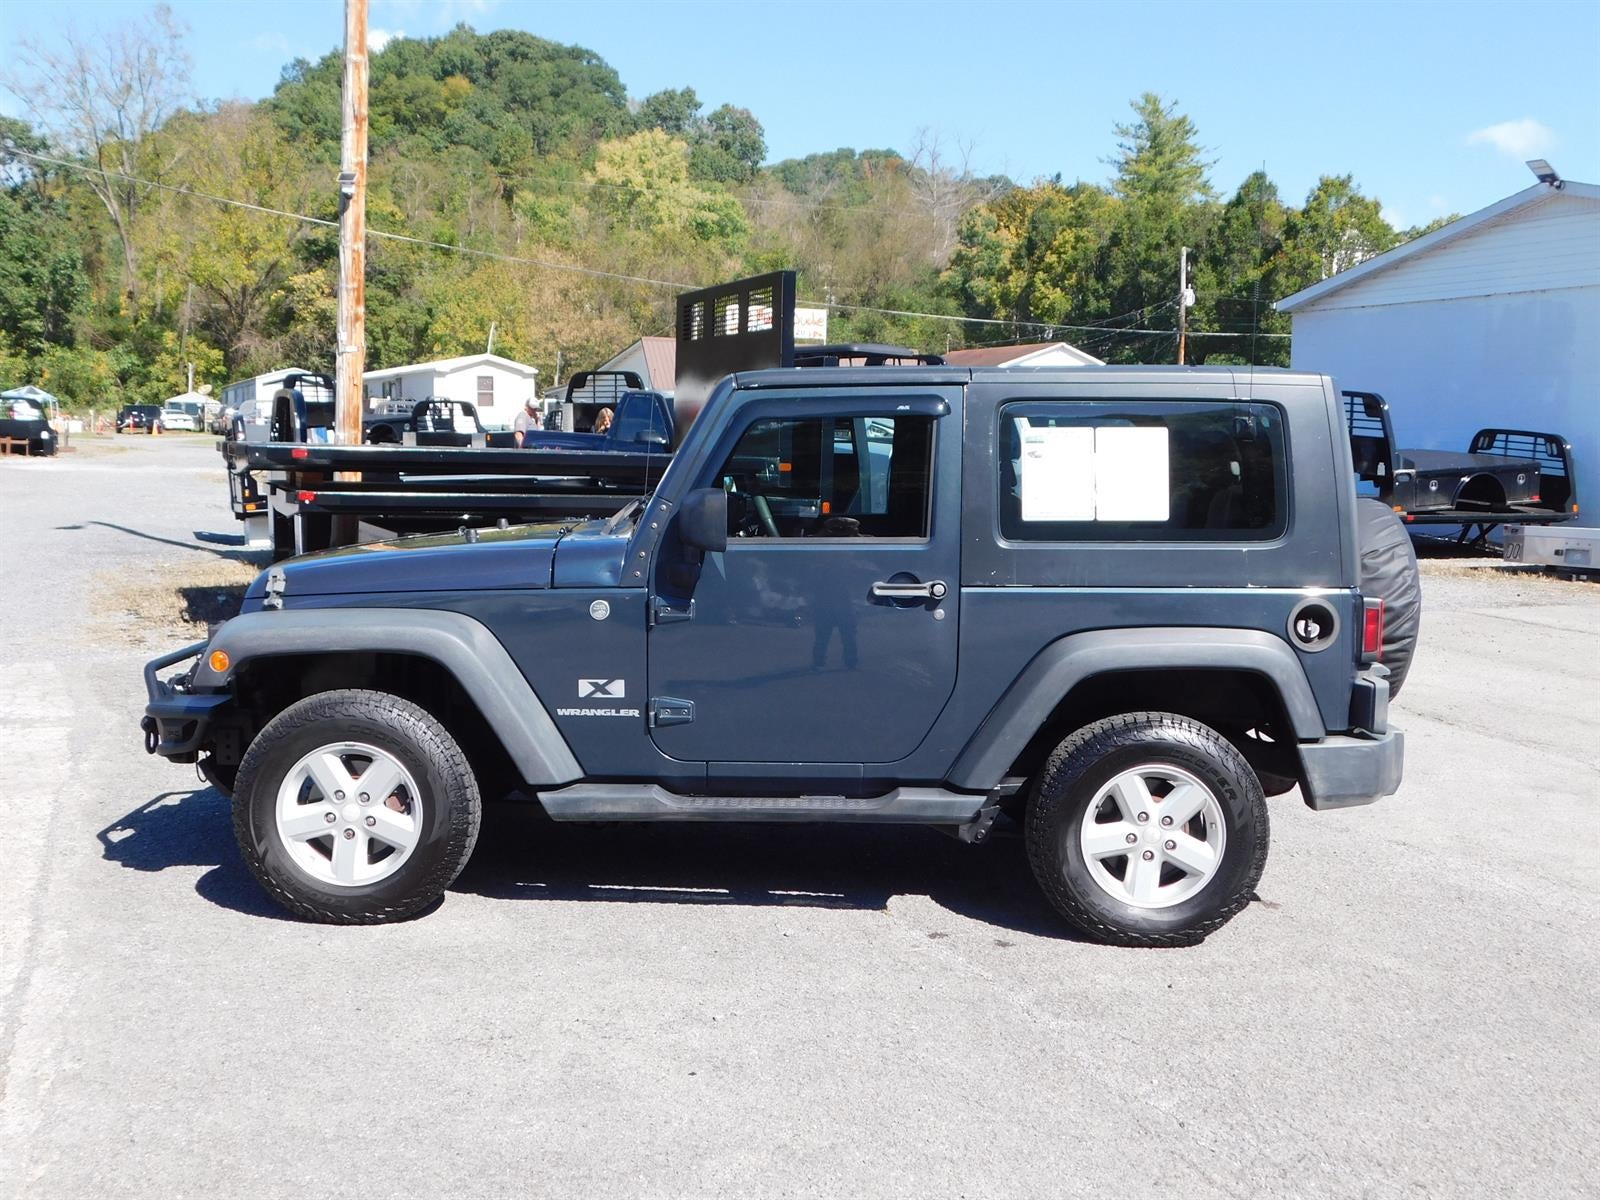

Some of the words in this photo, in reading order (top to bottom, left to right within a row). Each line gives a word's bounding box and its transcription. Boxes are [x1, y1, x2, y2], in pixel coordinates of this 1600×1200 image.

[582, 679, 619, 698] X
[557, 708, 640, 717] WRANGLER
[1171, 750, 1238, 801] COOPER
